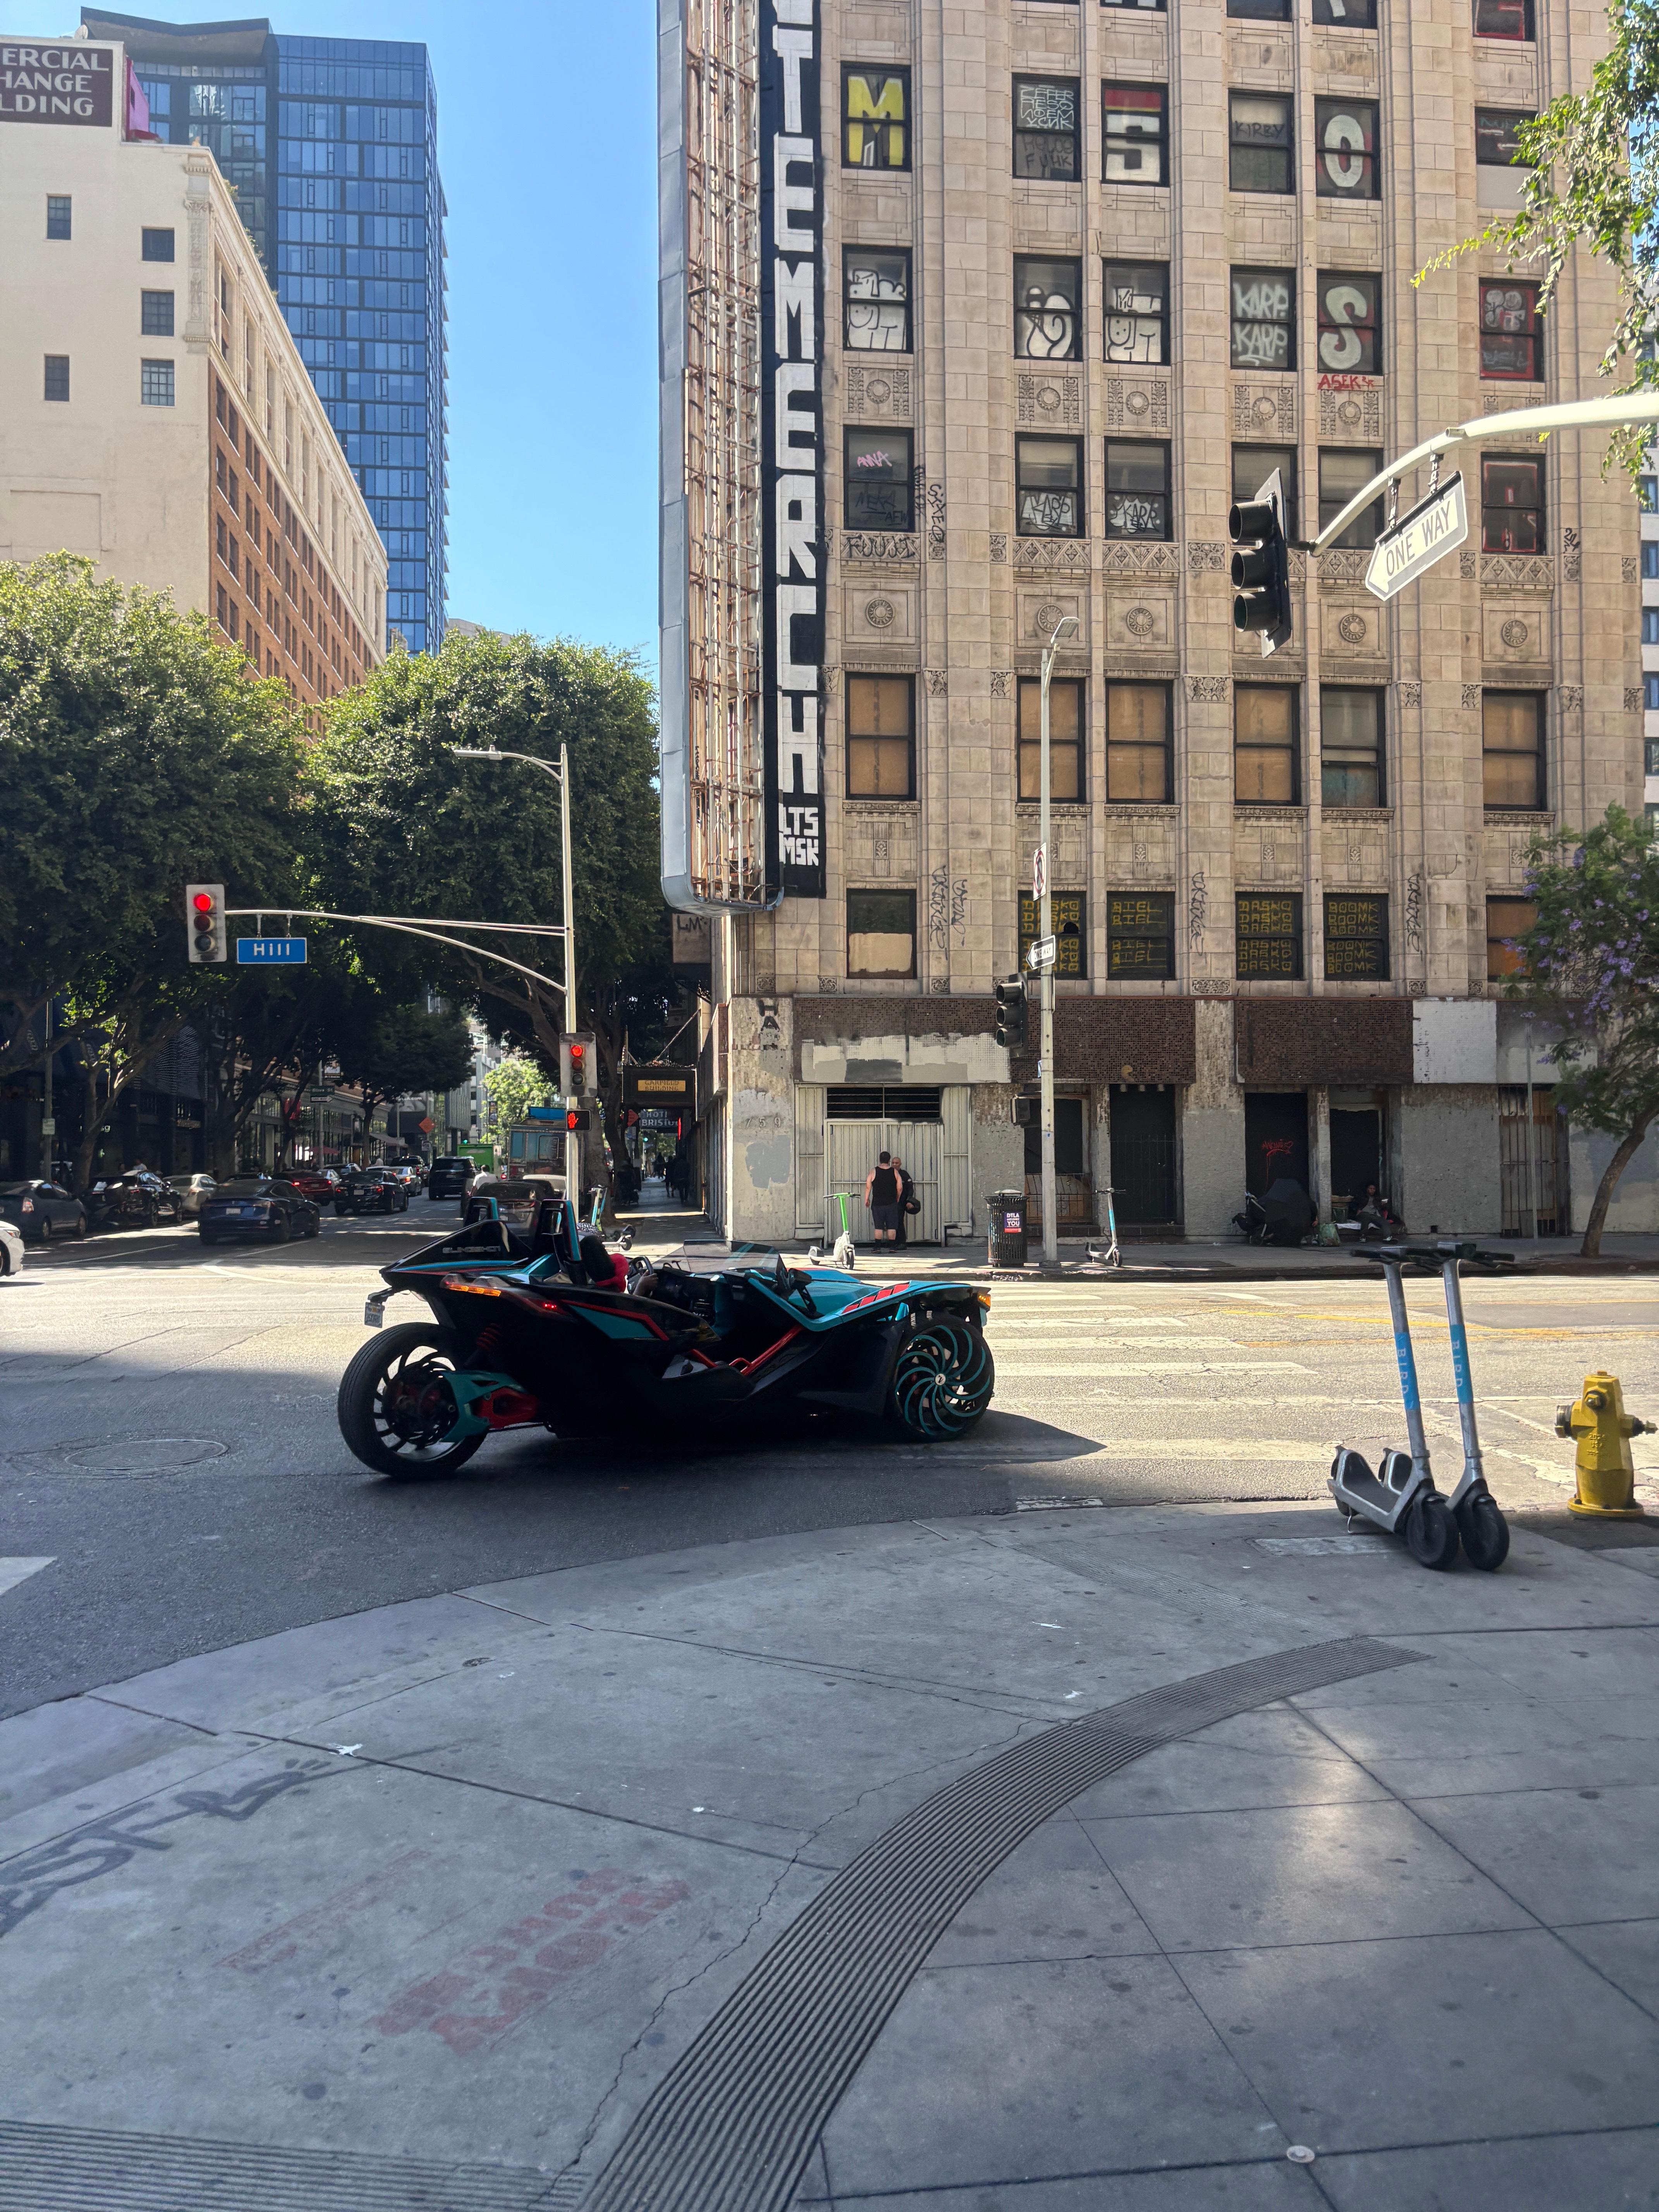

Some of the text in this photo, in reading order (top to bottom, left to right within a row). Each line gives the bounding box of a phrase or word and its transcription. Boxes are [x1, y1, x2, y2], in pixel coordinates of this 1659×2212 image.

[1386, 500, 1450, 576] ONE WAY
[779, 807, 818, 836] LTS
[779, 833, 819, 866] MSK
[253, 943, 290, 956] Hill
[1043, 946, 1051, 956] WAY
[1397, 1348, 1409, 1395] BIRD
[1452, 1340, 1463, 1388] BIRD
